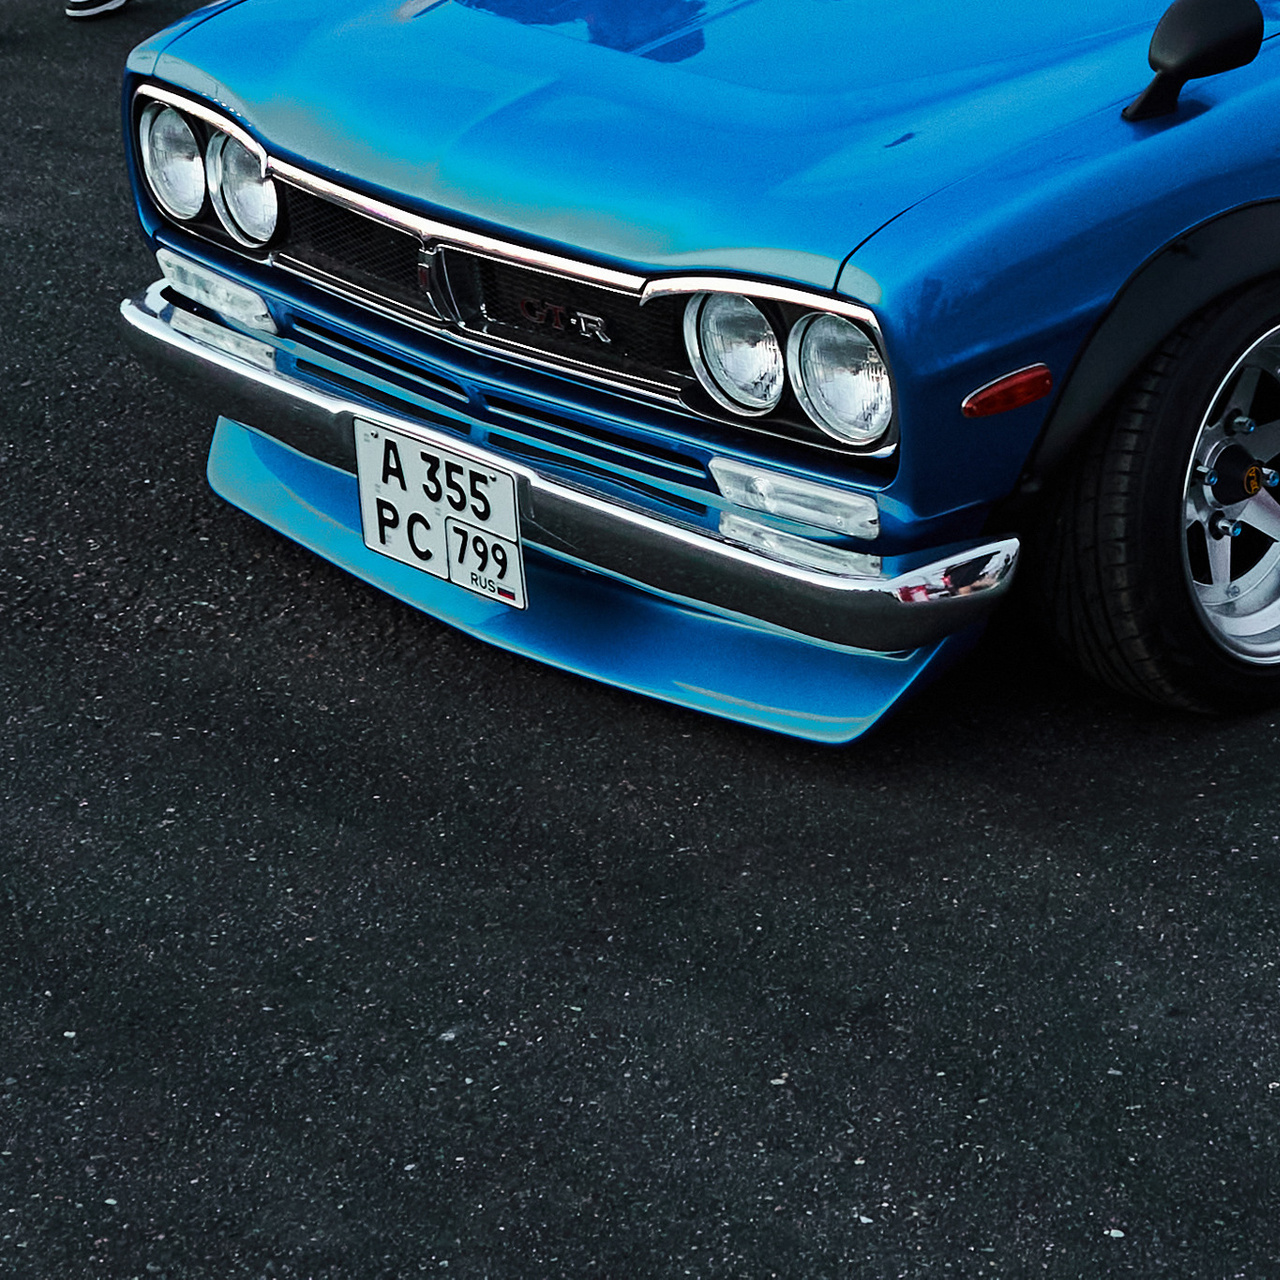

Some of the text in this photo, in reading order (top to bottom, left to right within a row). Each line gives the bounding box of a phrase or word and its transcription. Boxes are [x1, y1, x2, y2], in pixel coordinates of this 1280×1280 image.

[381, 437, 491, 522] A 355
[452, 525, 508, 580] 799
[469, 571, 496, 594] RUS
